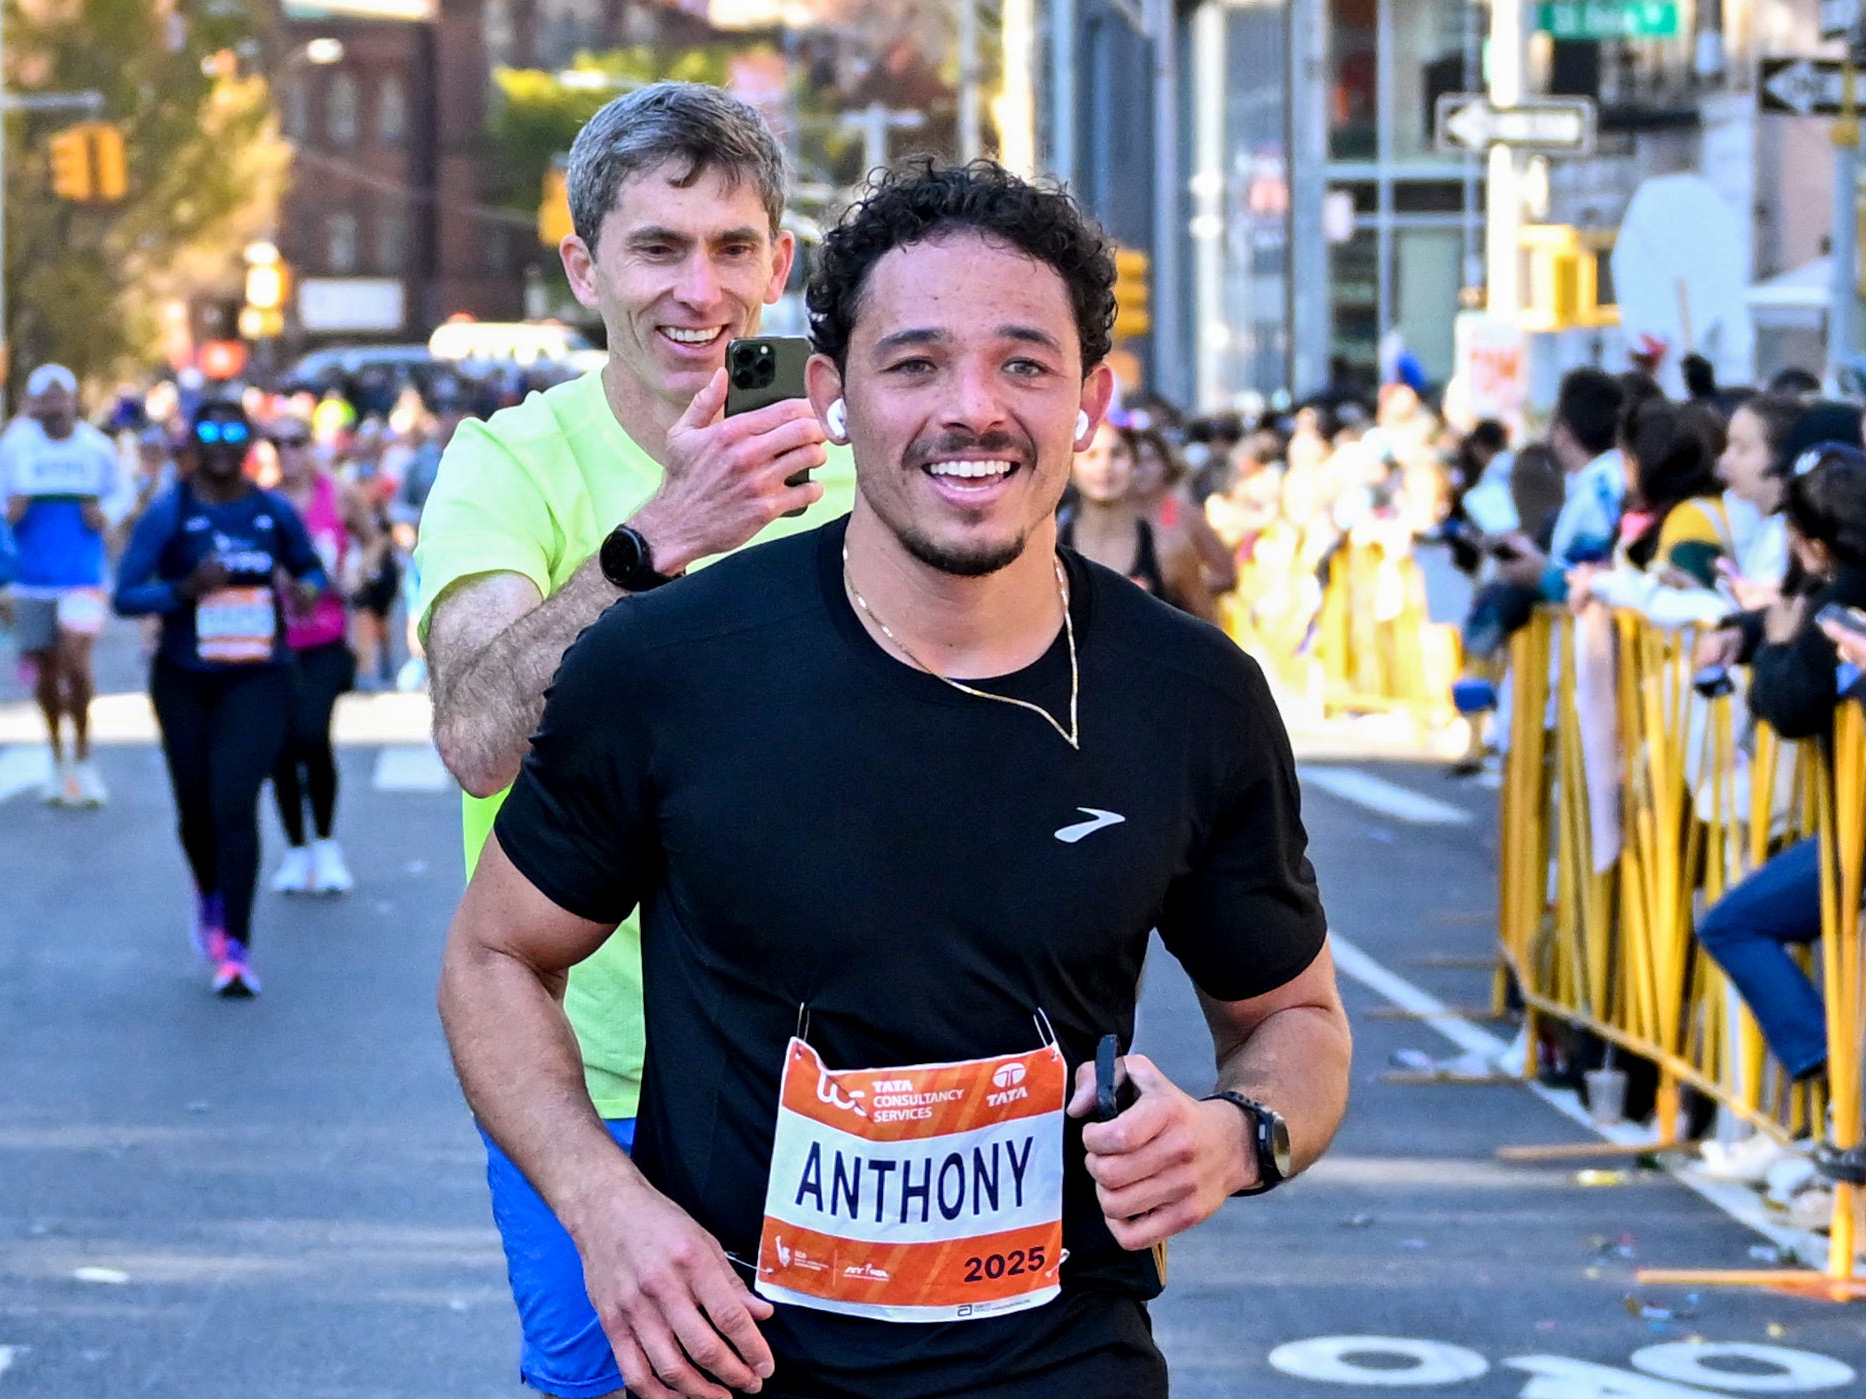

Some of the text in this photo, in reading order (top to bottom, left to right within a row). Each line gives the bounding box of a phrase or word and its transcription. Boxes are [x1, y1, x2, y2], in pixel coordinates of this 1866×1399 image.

[872, 1079, 913, 1093] TATA
[873, 1088, 965, 1108] CONSULTANCY
[985, 1086, 1029, 1108] TATA
[873, 1106, 933, 1123] SERVICES
[794, 1135, 1035, 1225] ANTHONY
[963, 1246, 1047, 1283] 2025
